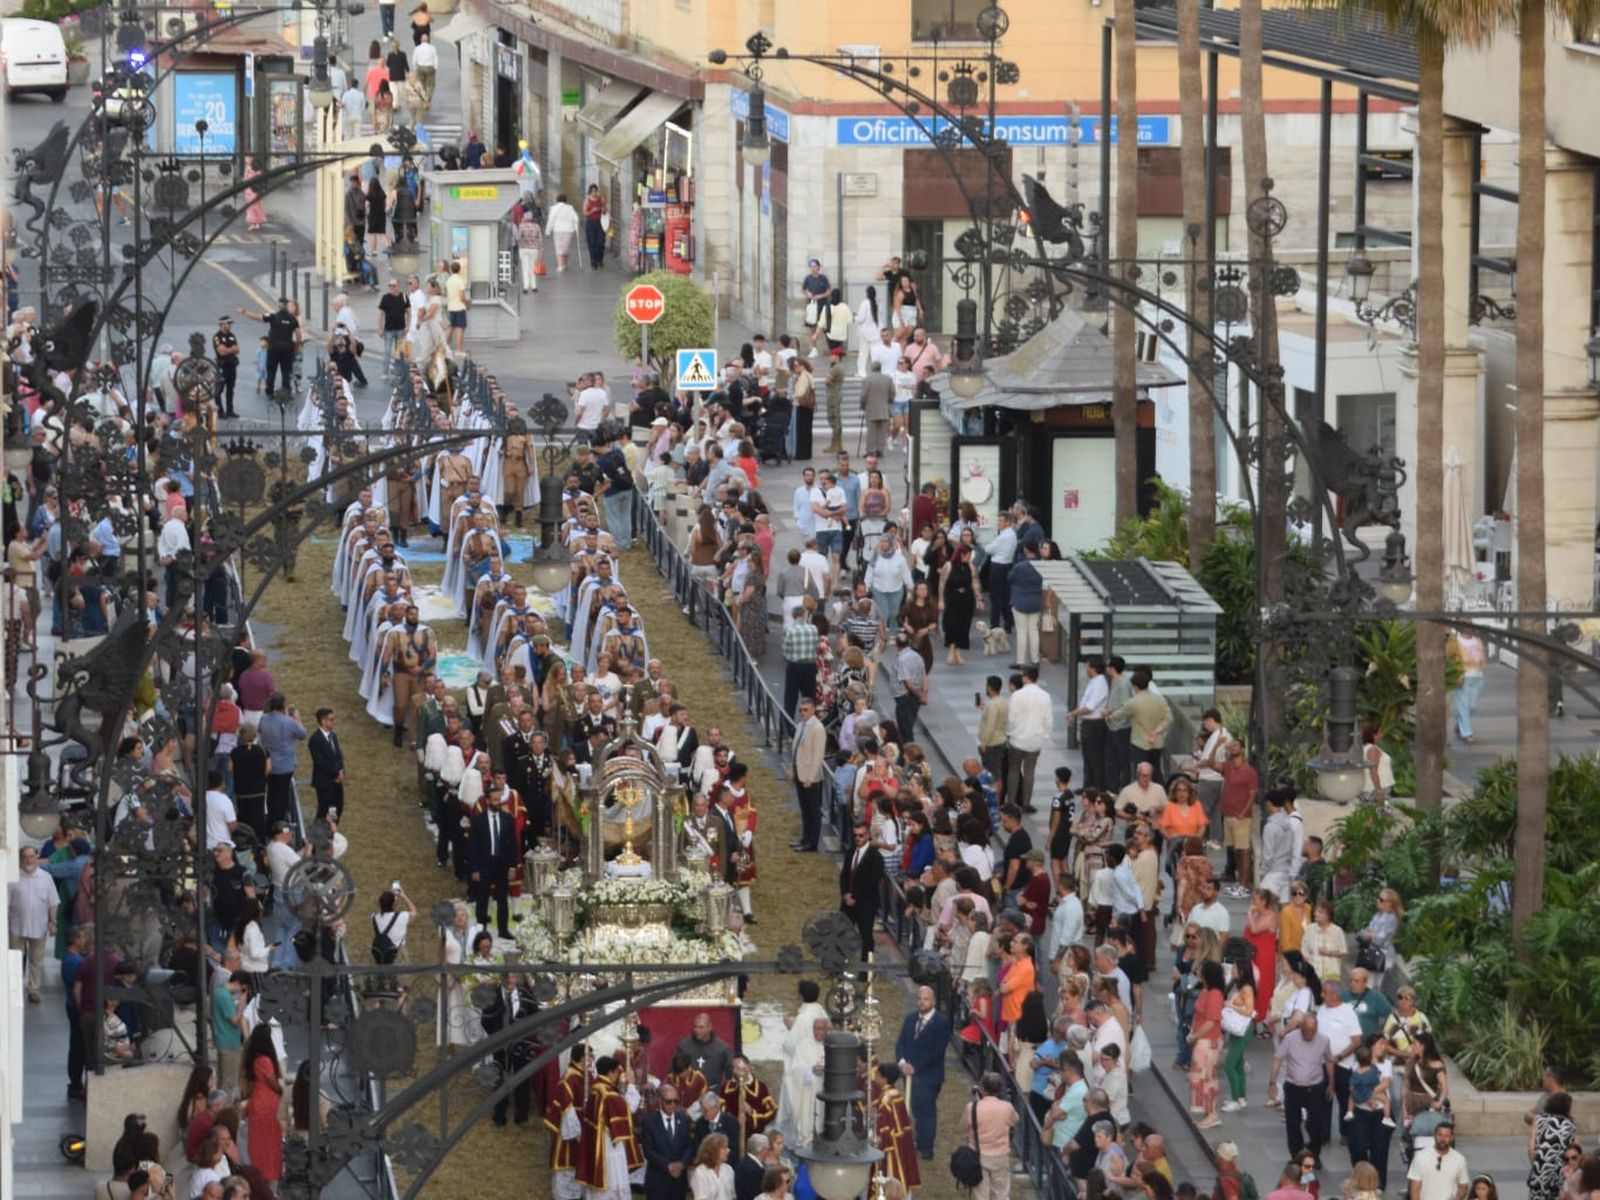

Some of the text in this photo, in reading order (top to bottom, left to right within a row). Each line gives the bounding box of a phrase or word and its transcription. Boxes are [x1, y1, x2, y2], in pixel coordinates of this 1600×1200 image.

[205, 101, 226, 121] 20
[853, 120, 930, 141] Oficina
[629, 299, 662, 309] STOP
